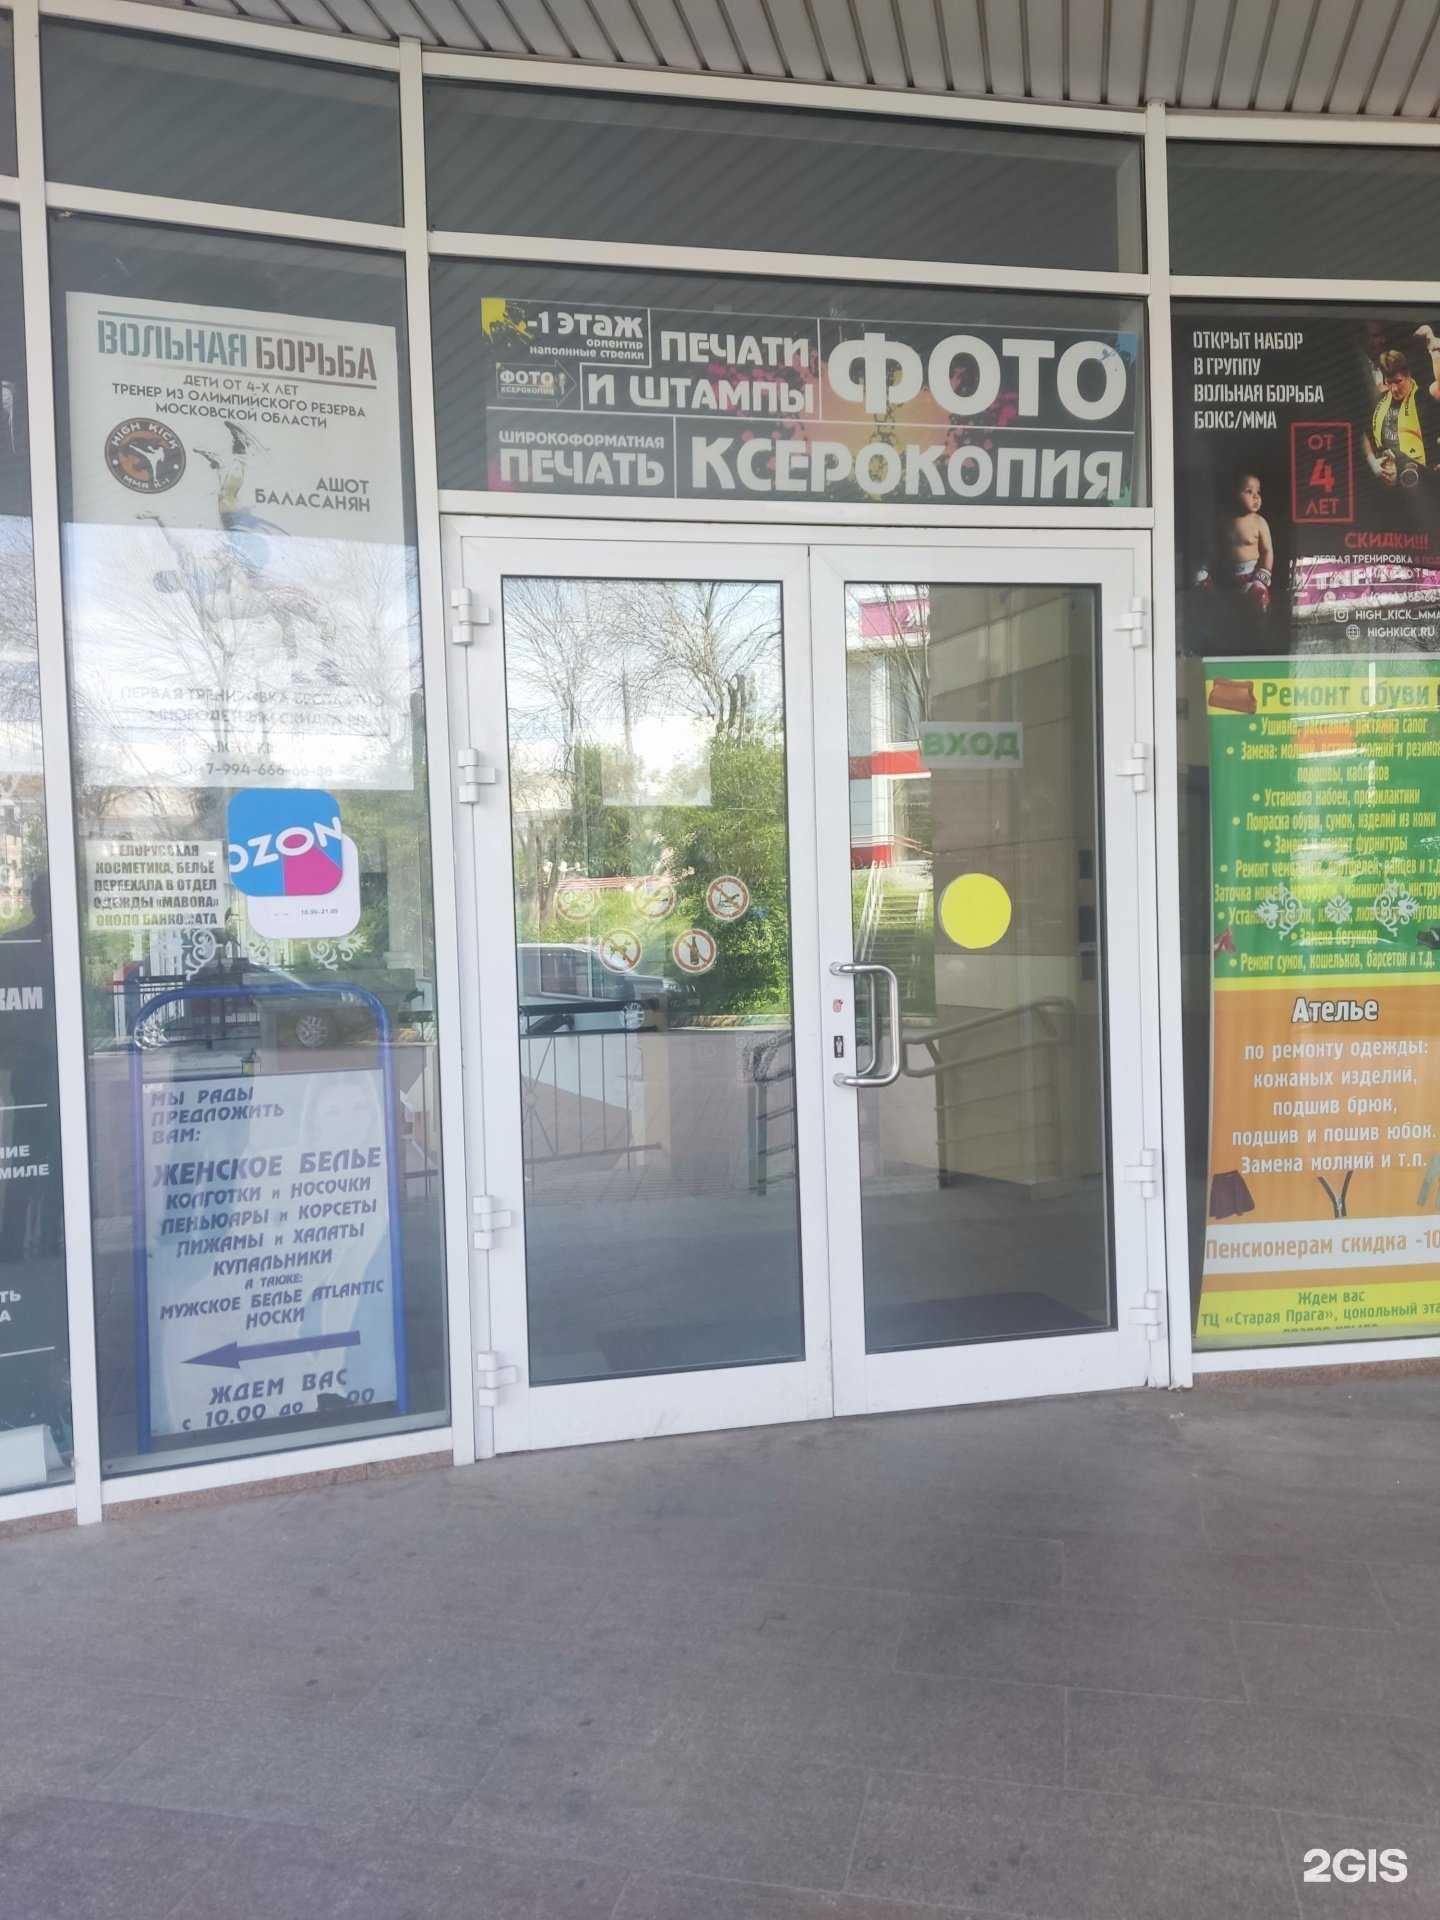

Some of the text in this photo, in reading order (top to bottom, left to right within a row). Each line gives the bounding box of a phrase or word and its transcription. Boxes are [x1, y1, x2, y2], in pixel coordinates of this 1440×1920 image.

[527, 311, 549, 334] -1
[97, 319, 377, 381] ВОЛЬНАЯ БОРЬБА
[660, 330, 809, 368] ПЕЧАТИ
[1193, 331, 1303, 350] ОТКРЫТ НАБОР
[600, 350, 645, 360] стрелки
[1194, 357, 1261, 376] В ГРУППУ
[184, 375, 299, 396] ДЕТИ ОТ 4-Х ЛЕТ
[500, 369, 554, 385] ФОТО
[827, 332, 1127, 420] ФОТО
[112, 382, 366, 418] ТРЕНЕР ИЗ ОЛИМПИЙСКОГО РЕЗЕРВА
[588, 373, 813, 413] И ШТАМПЫ
[1194, 383, 1324, 403] ВОЛЬНАЯ БОРЬБА
[156, 402, 327, 428] МОСКОВСКОЙ ОБЛАСТИ
[1194, 410, 1277, 429] БОКС/ММА
[111, 422, 178, 449] HIGH KICK
[499, 430, 664, 449] ШИРОКОФОРМАТНАЯ
[1307, 433, 1333, 450] ОТ
[500, 448, 664, 487] ПЕЧАТЬ
[692, 436, 1123, 500] КСЕРОКОПИЯ
[1310, 458, 1334, 492] 4
[316, 477, 370, 495] АШОТ
[255, 488, 370, 513] БАЛАСАНЯН
[1305, 499, 1339, 515] ЛЕТ
[1352, 554, 1413, 564] ТРЕНИРОВКА
[1368, 626, 1435, 638] HIGHKICK.RU
[1262, 681, 1429, 709] Ремонт обуви
[1403, 717, 1428, 734] сапог
[925, 732, 1020, 760] ВХОД
[228, 816, 342, 873] OZON
[177, 879, 217, 893] ОТДЕЛ
[1240, 952, 1273, 971] Ремонт
[1291, 996, 1379, 1023] Ателье
[1244, 1040, 1428, 1063] по ремонту одежды:
[1254, 1066, 1417, 1088] кожаных изделий,
[152, 1086, 254, 1107] МЫ РАДЫ
[1273, 1096, 1397, 1117] подшив брюк,
[152, 1103, 284, 1127] ПРЕДЛОЖИТЬ
[152, 1128, 201, 1145] ВАМ:
[1232, 1122, 1437, 1148] подшив и пошив юбок.
[152, 1147, 381, 1187] ЖЕНСКОЕ БЕЛЬЕ
[1241, 1152, 1427, 1174] Замена молний и т.п.
[166, 1176, 371, 1210] КОЛГОТКИ и НОСОЧКИ
[161, 1199, 377, 1236] ПЕНЬЮАРЫ и КОРСЕТЫ
[176, 1223, 364, 1258] ПИЖАМЫ и ХАЛАТЫ
[1205, 1237, 1333, 1260] Пенсионерам
[1341, 1233, 1407, 1255] скидка
[213, 1249, 333, 1276] КУПАЛЬНИКИ
[245, 1274, 303, 1290] А ТАКЖЕ:
[160, 1280, 385, 1320] МУЖСКОЕ БЕЛЬЕ ATLANTIC
[1298, 1290, 1365, 1306] Ждем вас
[246, 1307, 305, 1329] НОСКИ
[1201, 1313, 1220, 1328] ТЦ
[1225, 1311, 1280, 1327] «Старая
[1285, 1308, 1338, 1325] Прага»,
[1344, 1302, 1418, 1320] цокольный
[209, 1368, 348, 1405] ЖДЕМ ВАС
[206, 1403, 267, 1428] 10.00
[279, 1402, 304, 1417] до
